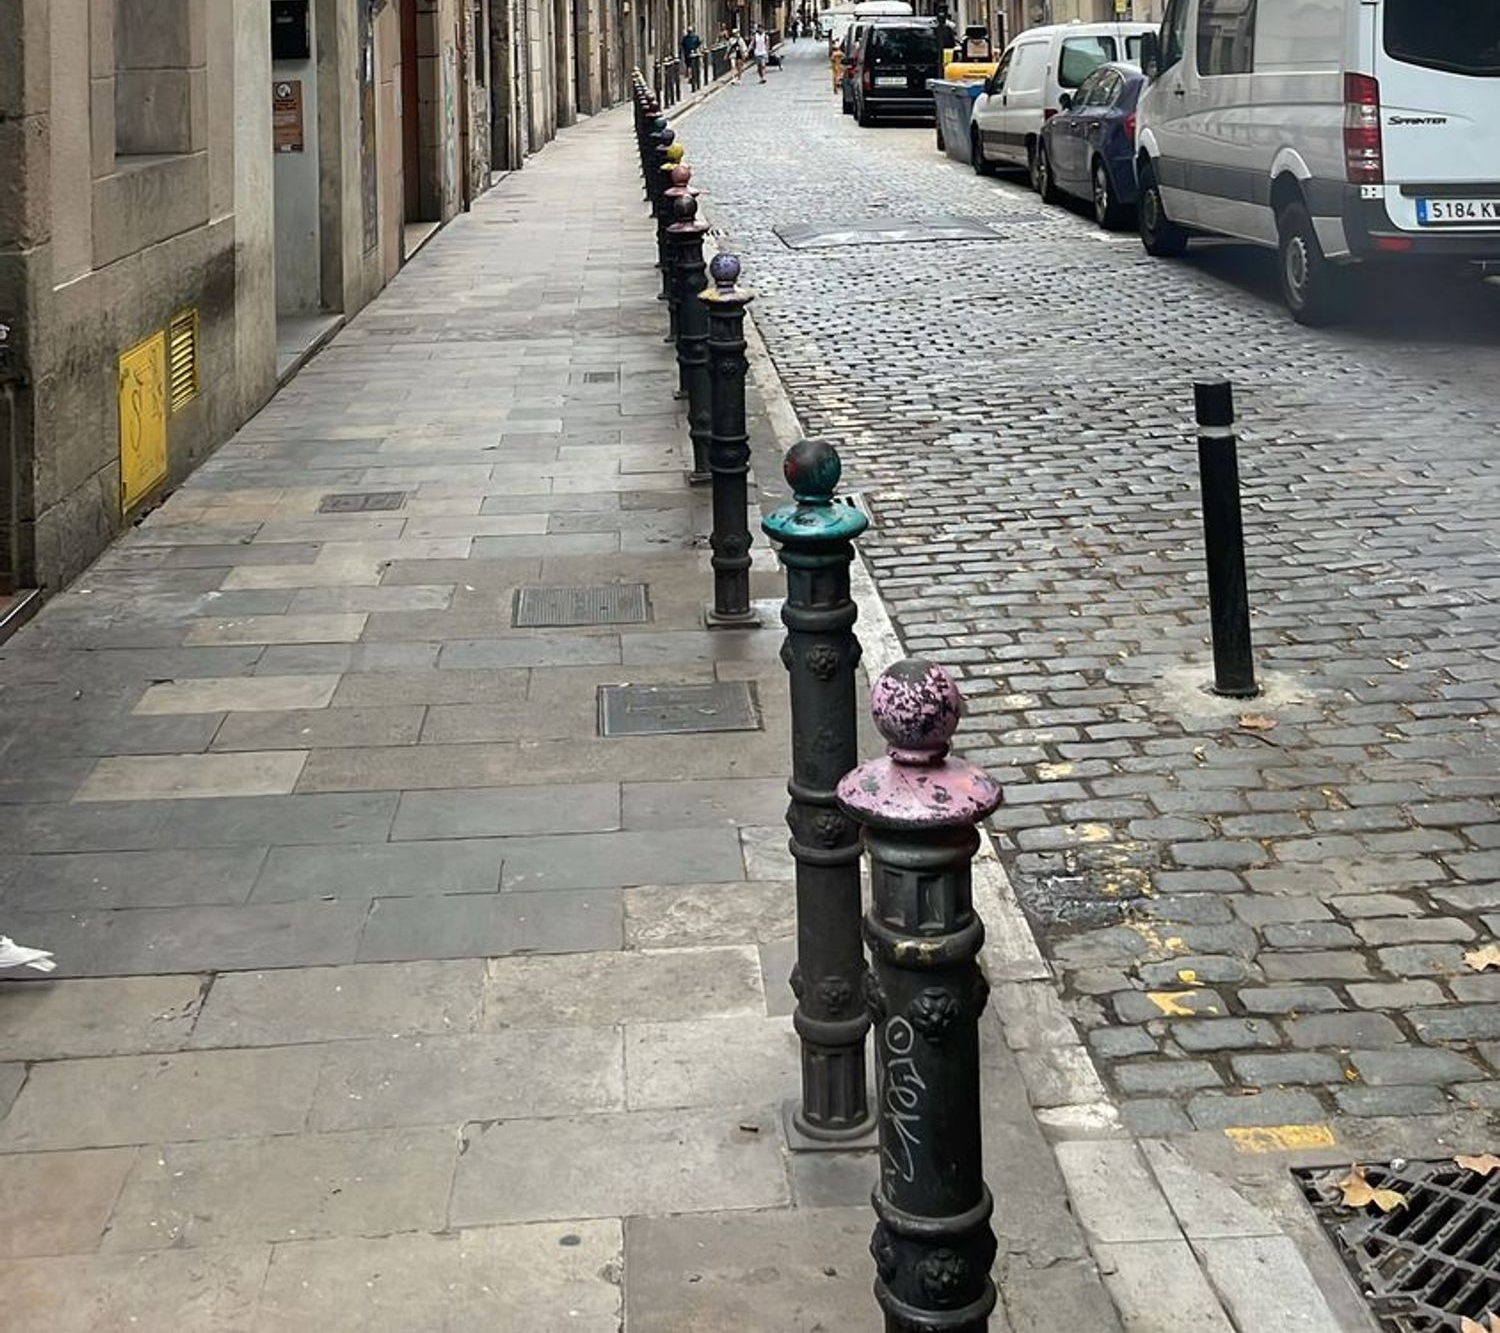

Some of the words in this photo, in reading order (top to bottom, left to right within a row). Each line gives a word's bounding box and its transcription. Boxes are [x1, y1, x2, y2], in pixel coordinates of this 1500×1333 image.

[1388, 116, 1447, 125] SPRINTER
[1432, 202, 1476, 218] 5184
[1480, 202, 1500, 218] K
